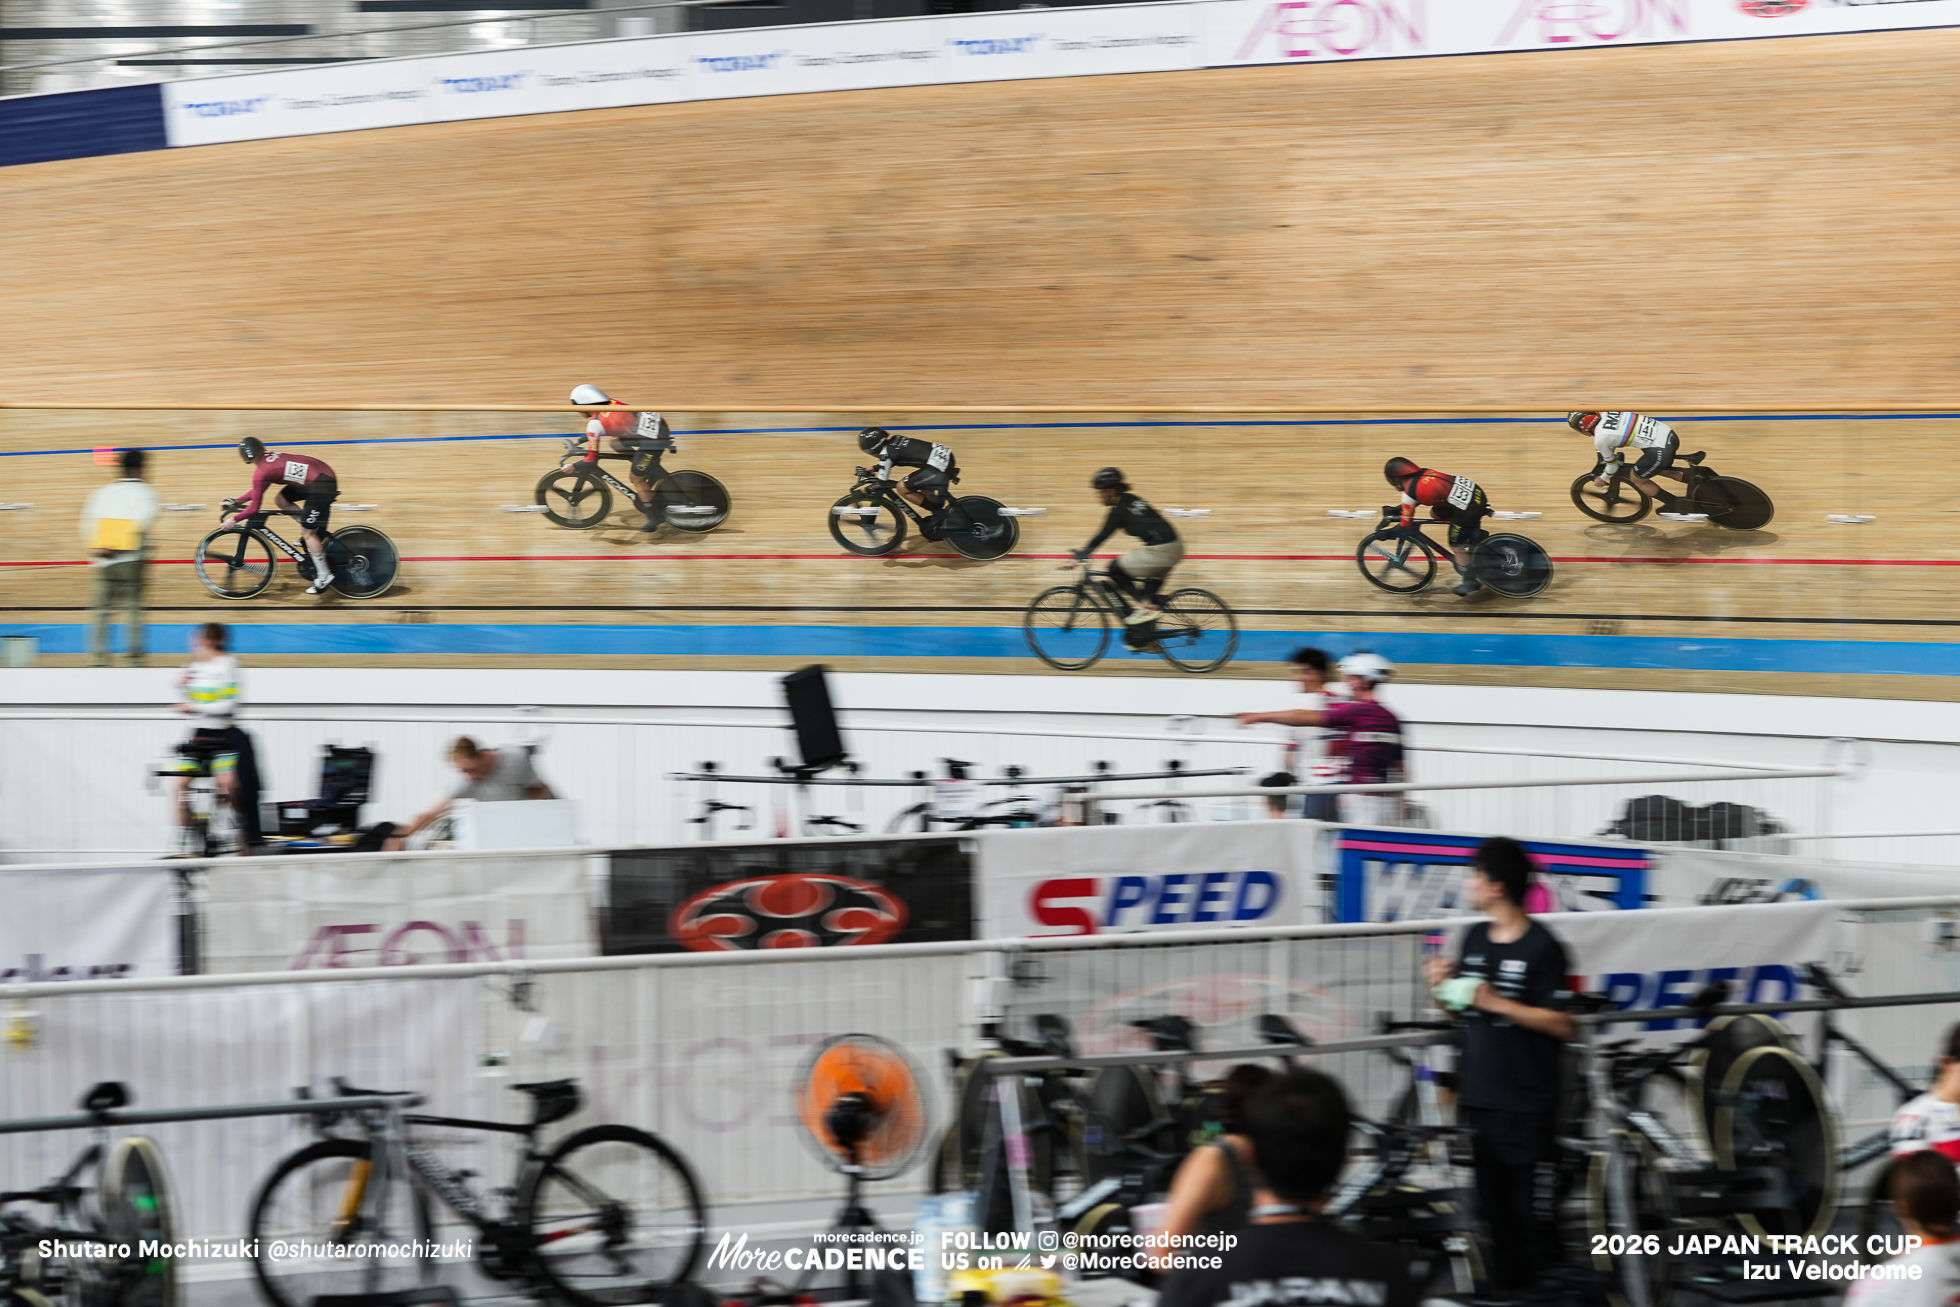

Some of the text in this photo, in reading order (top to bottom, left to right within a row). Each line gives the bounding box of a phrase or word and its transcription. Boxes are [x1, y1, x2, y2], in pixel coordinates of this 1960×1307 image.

[601, 474, 637, 501] KOGA
[1453, 486, 1469, 501] 133
[1027, 871, 1281, 937] SPEED
